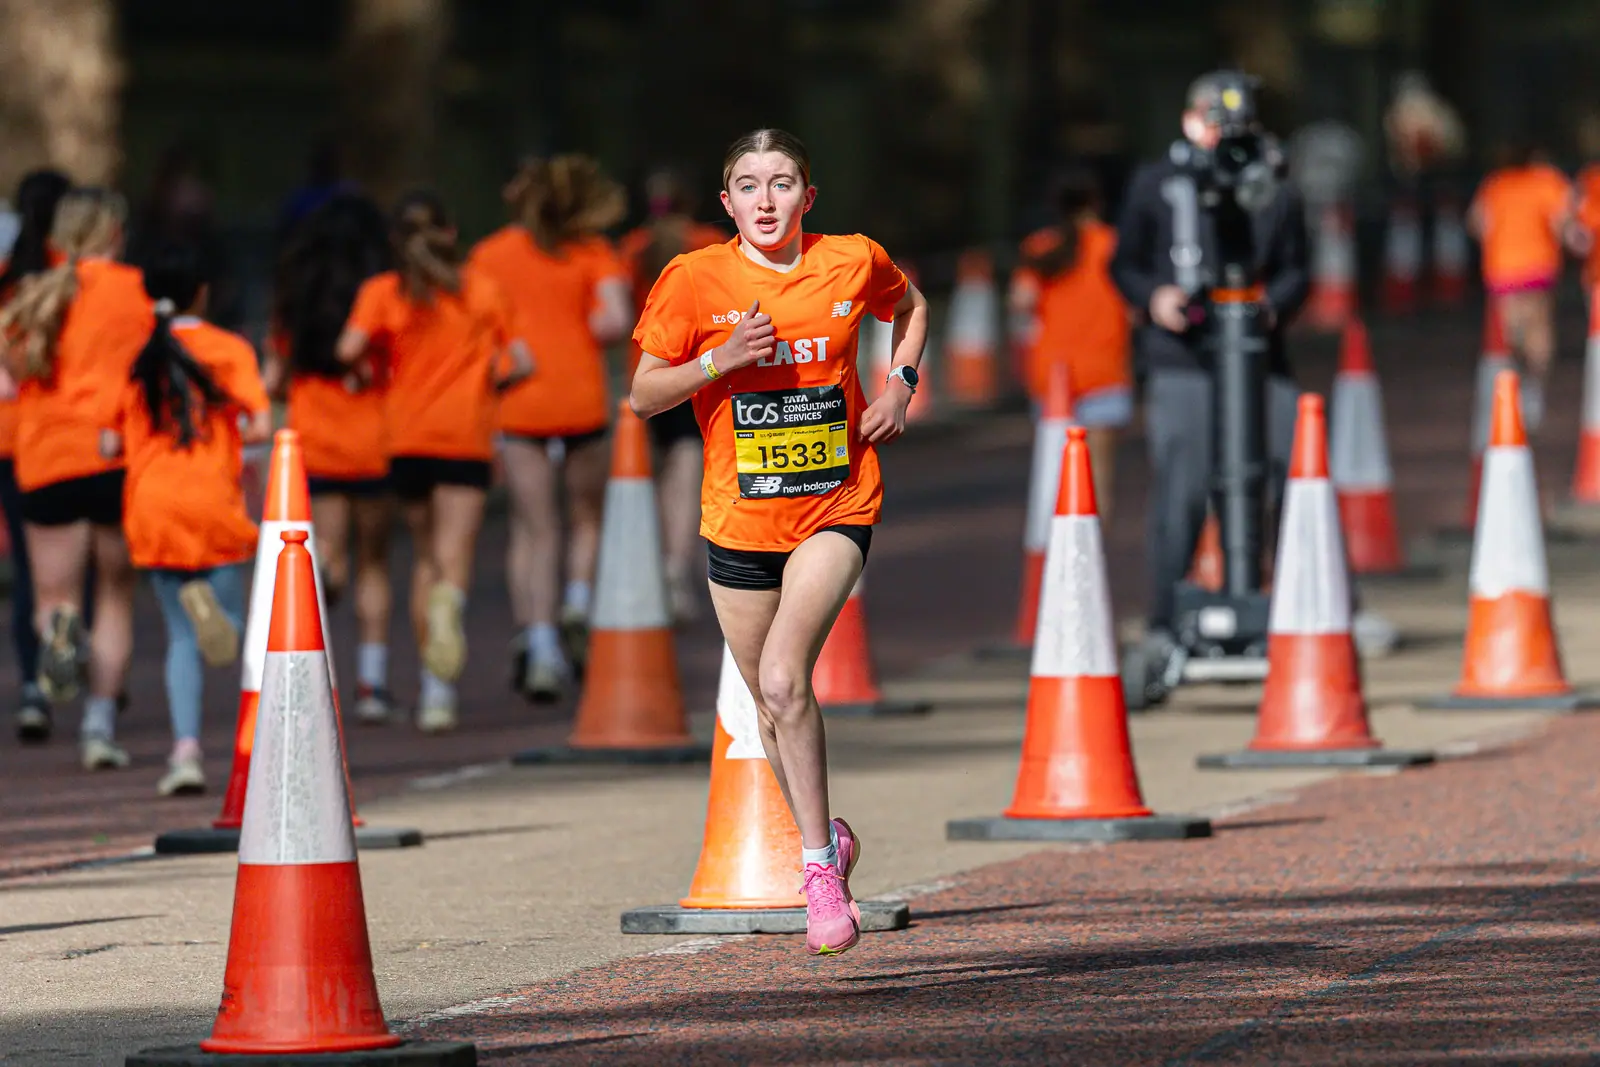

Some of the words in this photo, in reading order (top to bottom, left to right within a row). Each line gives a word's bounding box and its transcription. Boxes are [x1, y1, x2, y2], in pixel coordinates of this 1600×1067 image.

[712, 314, 727, 324] tcs
[782, 394, 808, 404] TATA
[783, 399, 842, 413] CONSULTANCY
[736, 399, 779, 425] tcs
[783, 411, 822, 423] SERVICES
[758, 441, 827, 469] 1533
[783, 485, 802, 494] new
[803, 480, 842, 492] balance
